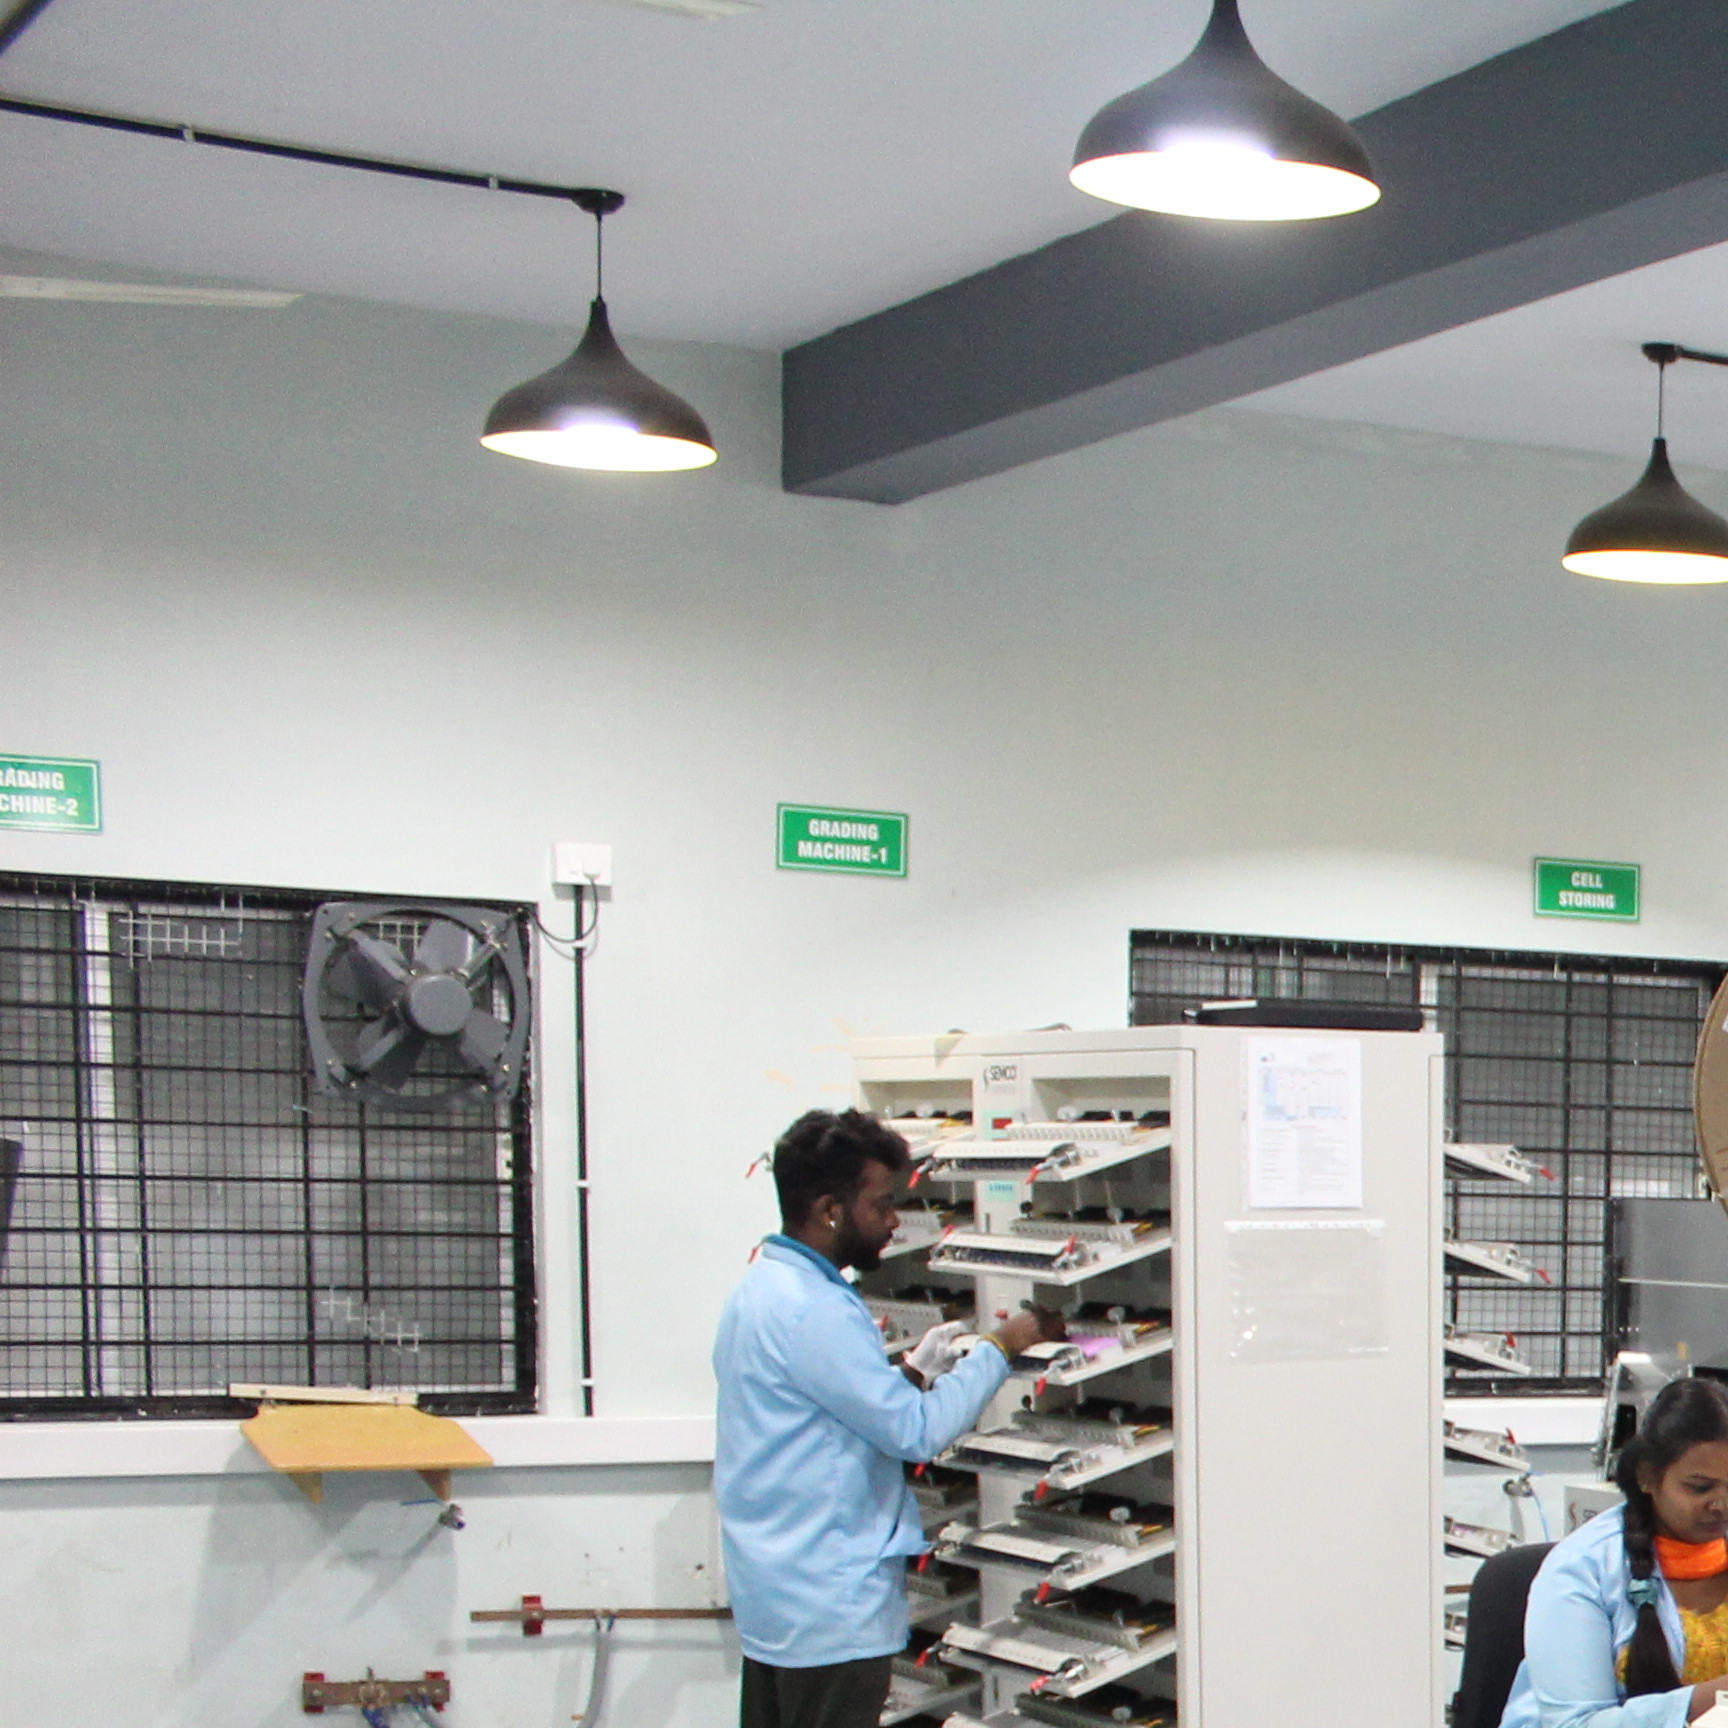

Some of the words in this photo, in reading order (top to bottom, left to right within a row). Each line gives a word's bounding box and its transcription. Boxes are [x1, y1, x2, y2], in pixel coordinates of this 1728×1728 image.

[0, 767, 65, 791] ADING
[808, 818, 879, 841] GRADING
[797, 840, 888, 864] MACHINE-1
[1571, 871, 1603, 888] CELL
[1558, 890, 1616, 909] STORING
